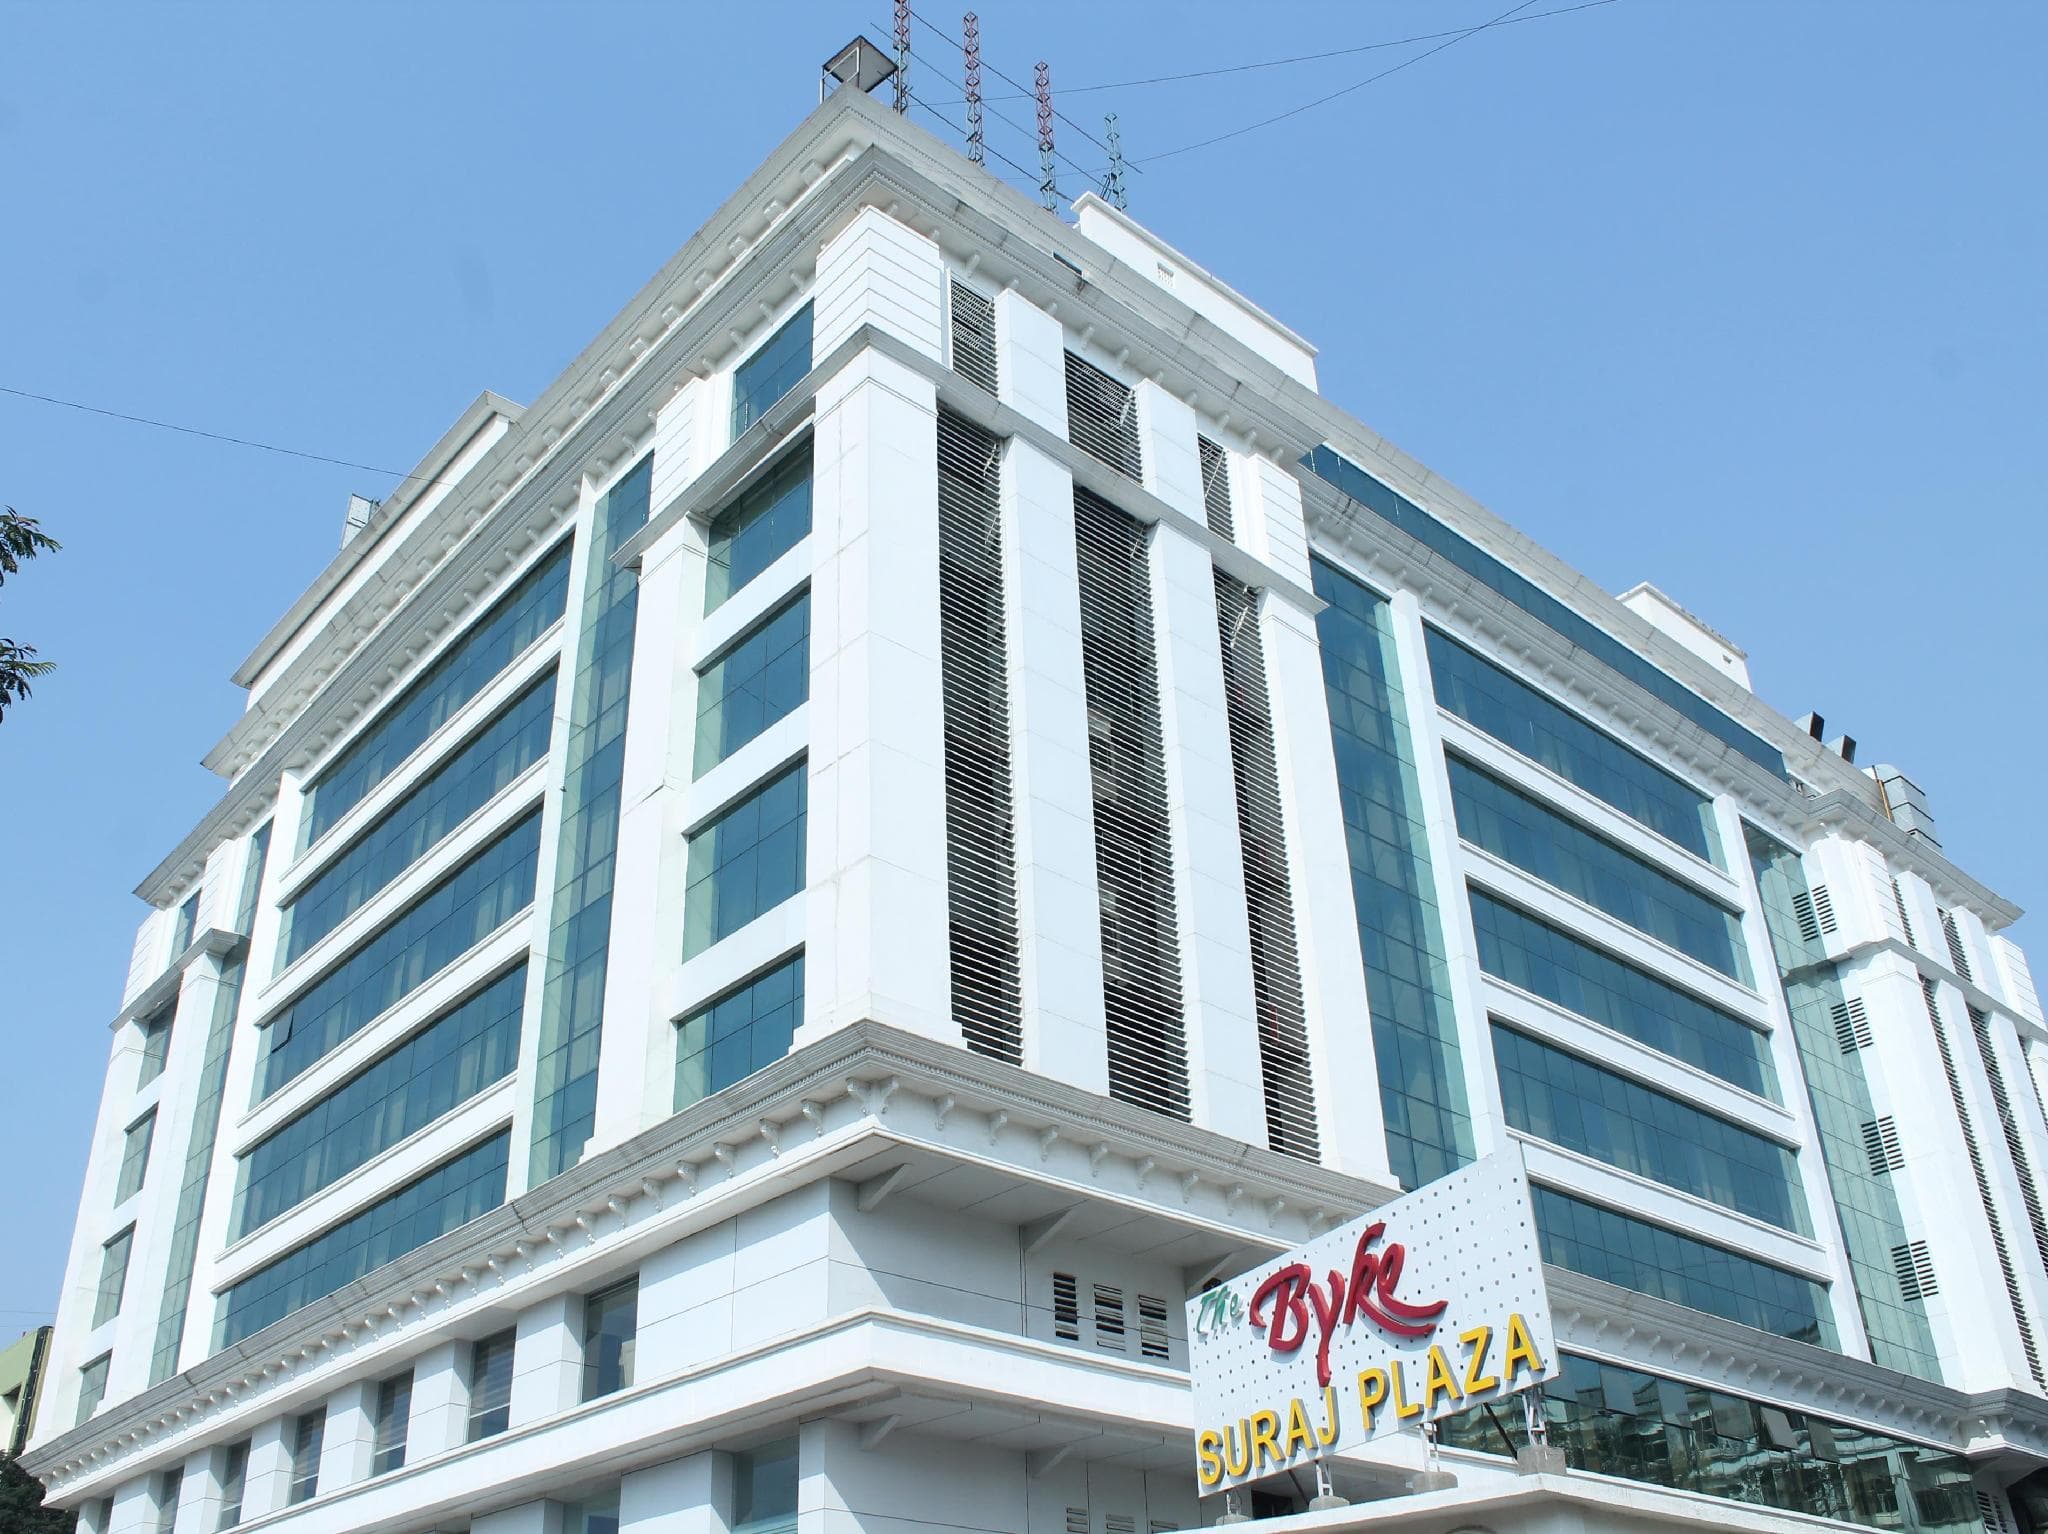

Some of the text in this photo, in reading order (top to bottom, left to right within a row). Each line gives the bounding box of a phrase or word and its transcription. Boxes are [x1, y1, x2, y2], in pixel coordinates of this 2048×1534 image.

[1198, 1222, 1448, 1387] The Byke
[1198, 1313, 1546, 1486] SURAJ PLAZA
